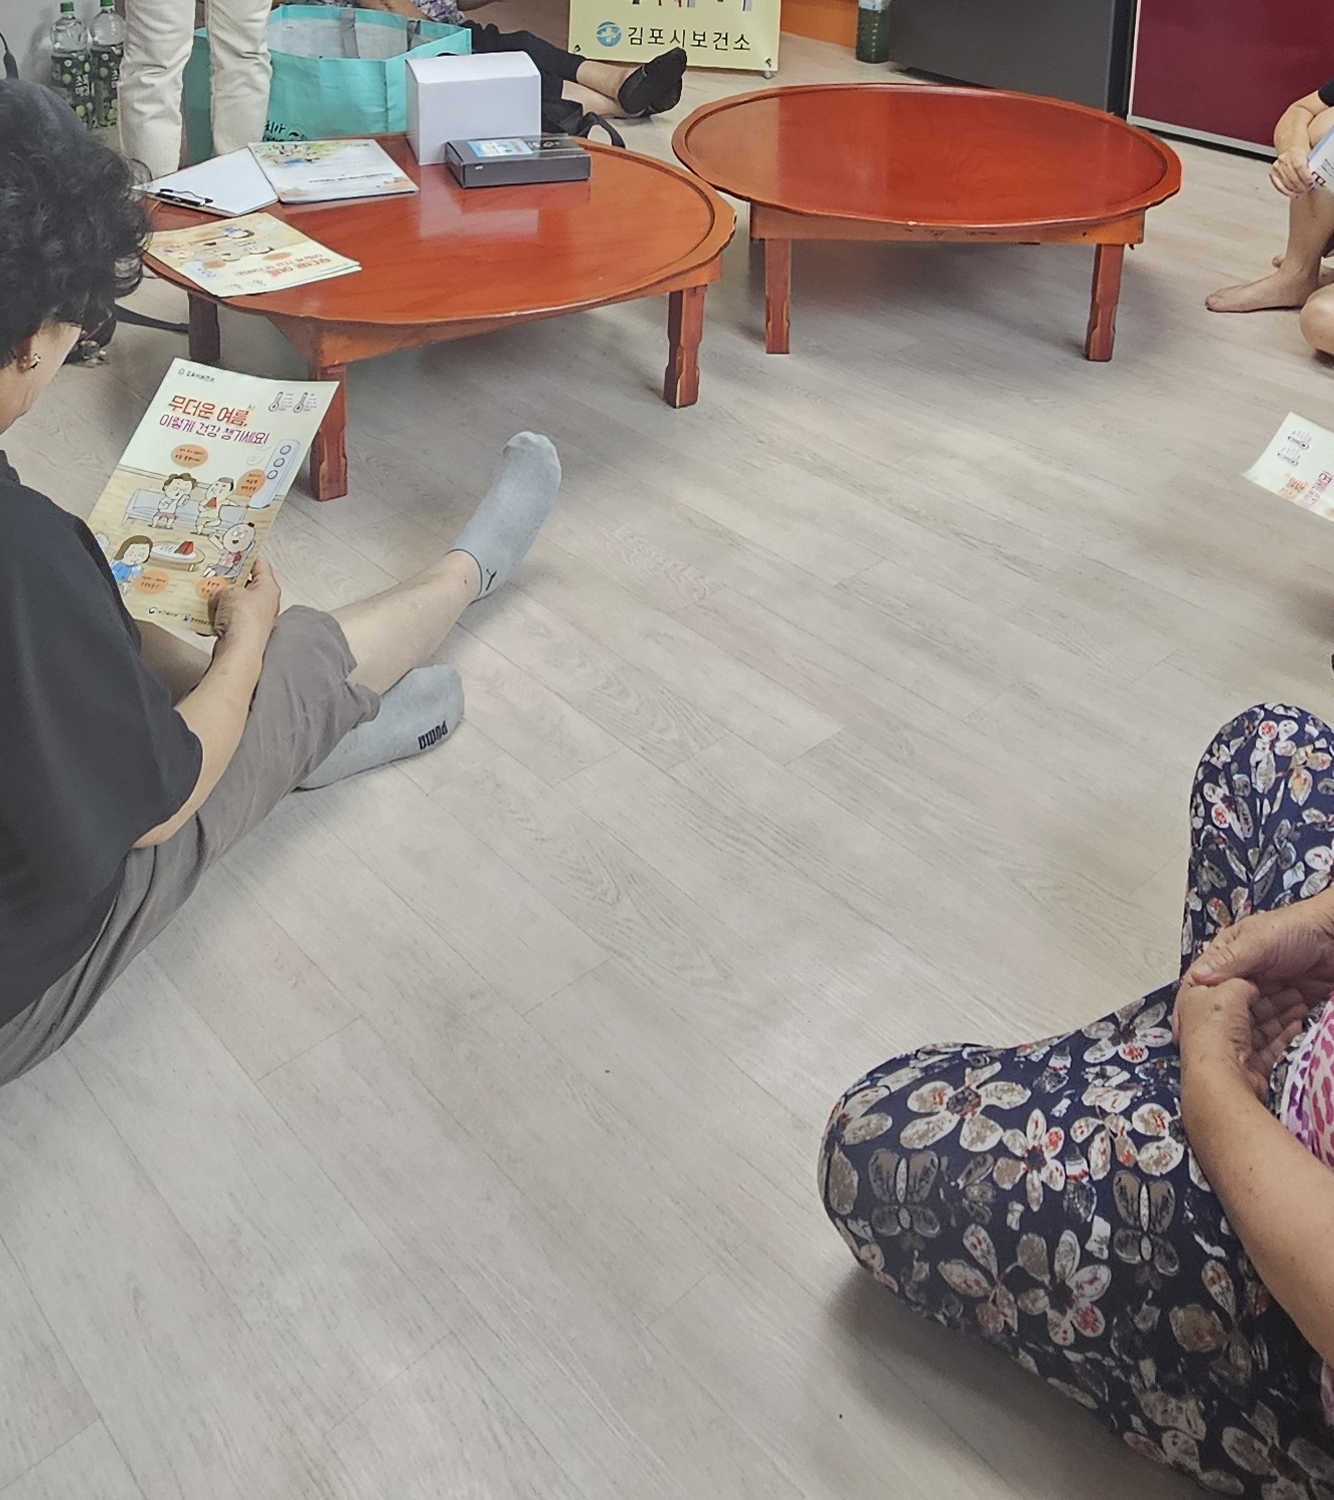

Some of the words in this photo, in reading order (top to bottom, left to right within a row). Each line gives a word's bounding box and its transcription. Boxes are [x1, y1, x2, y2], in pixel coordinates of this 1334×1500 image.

[628, 26, 751, 51] 김포시보건소
[168, 395, 215, 420] 무더운
[159, 414, 196, 433] 이렇게
[196, 422, 221, 438] 건강
